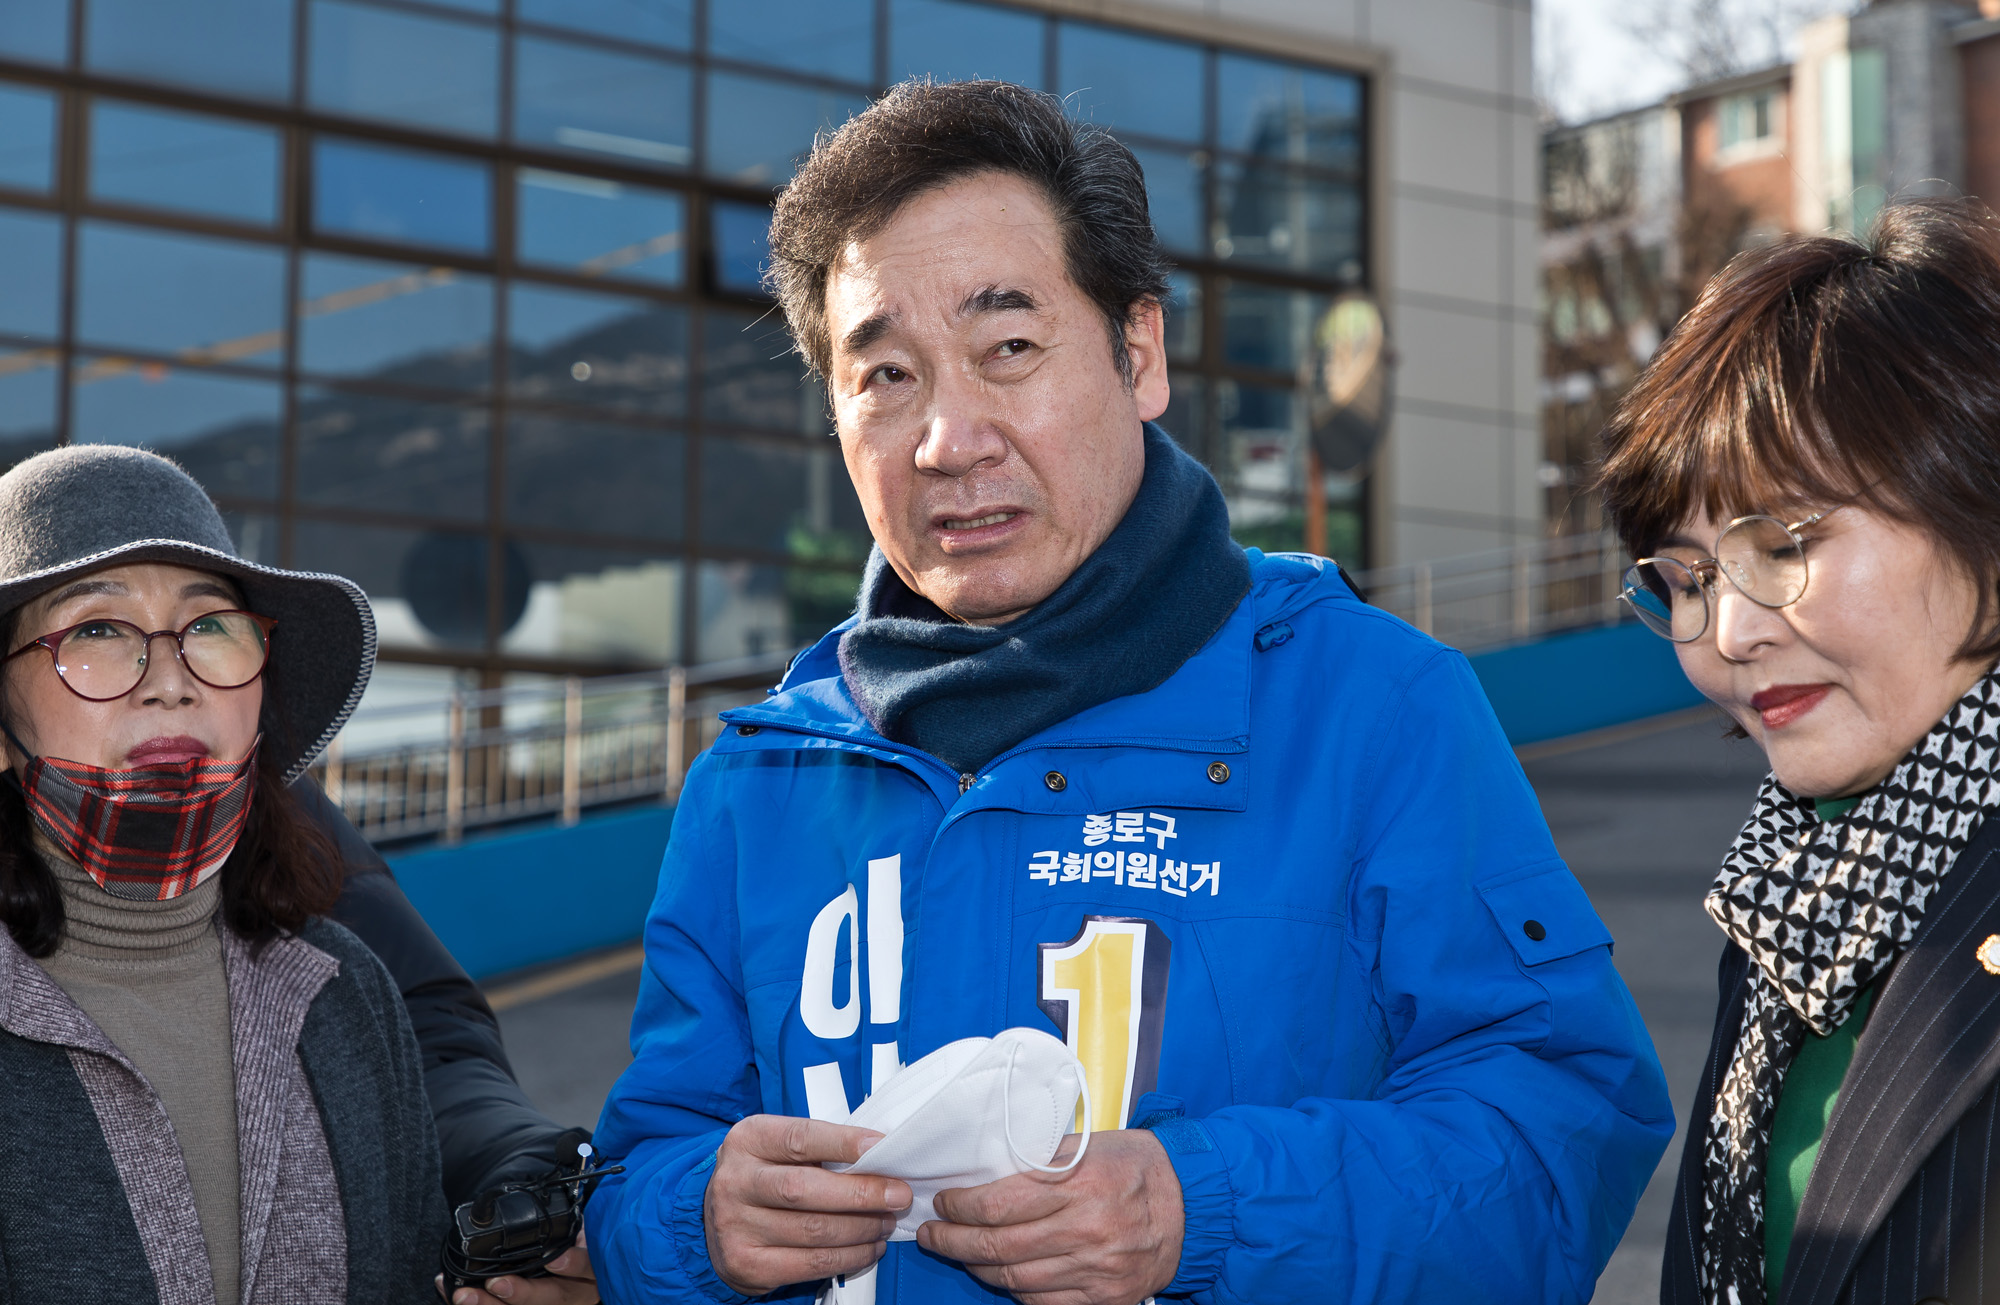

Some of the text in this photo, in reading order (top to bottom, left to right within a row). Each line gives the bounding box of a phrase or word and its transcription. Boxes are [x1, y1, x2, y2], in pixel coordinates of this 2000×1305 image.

[1082, 812, 1178, 850] 종로구
[1028, 850, 1221, 898] 국회의원선거
[1038, 915, 1168, 1131] 1
